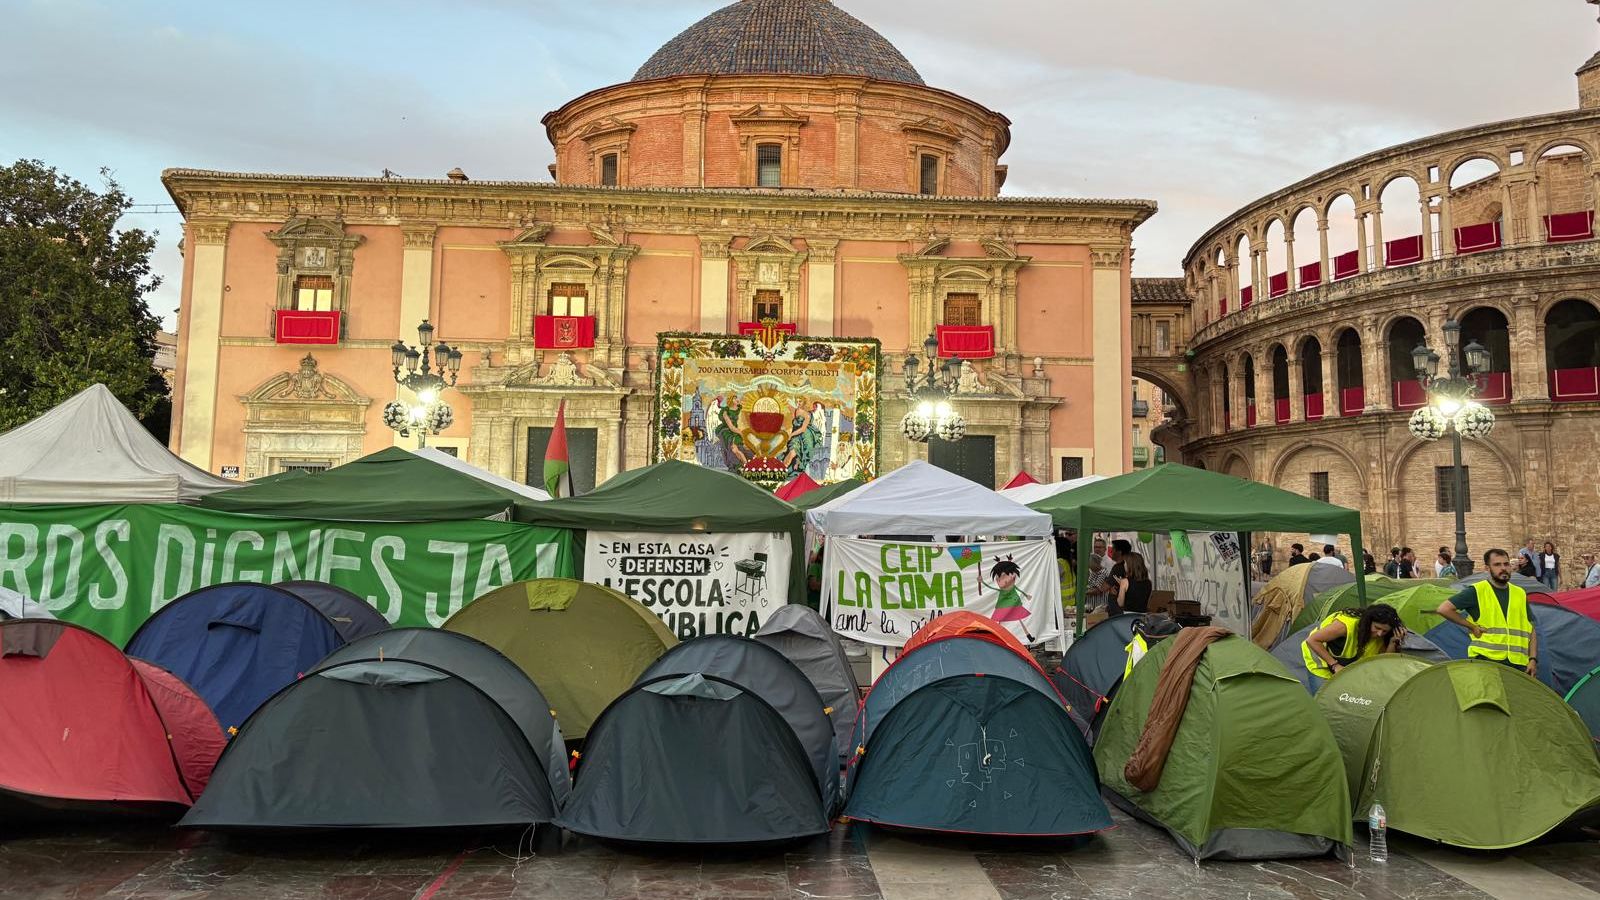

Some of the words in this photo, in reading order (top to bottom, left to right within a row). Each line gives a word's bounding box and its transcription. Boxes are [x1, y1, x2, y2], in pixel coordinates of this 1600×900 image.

[713, 366, 769, 375] ANIVERSARIO
[770, 368, 804, 376] CORPUS
[804, 369, 839, 377] CHRISTI
[1213, 532, 1230, 544] NO
[612, 541, 631, 554] EN
[638, 542, 672, 555] ESTA
[678, 543, 715, 556] CASA
[880, 543, 944, 574] CEIP
[625, 559, 706, 574] DEFENSEM
[837, 570, 873, 609] LA
[878, 571, 965, 610] COMA
[835, 609, 872, 633] amb
[880, 610, 899, 635] la
